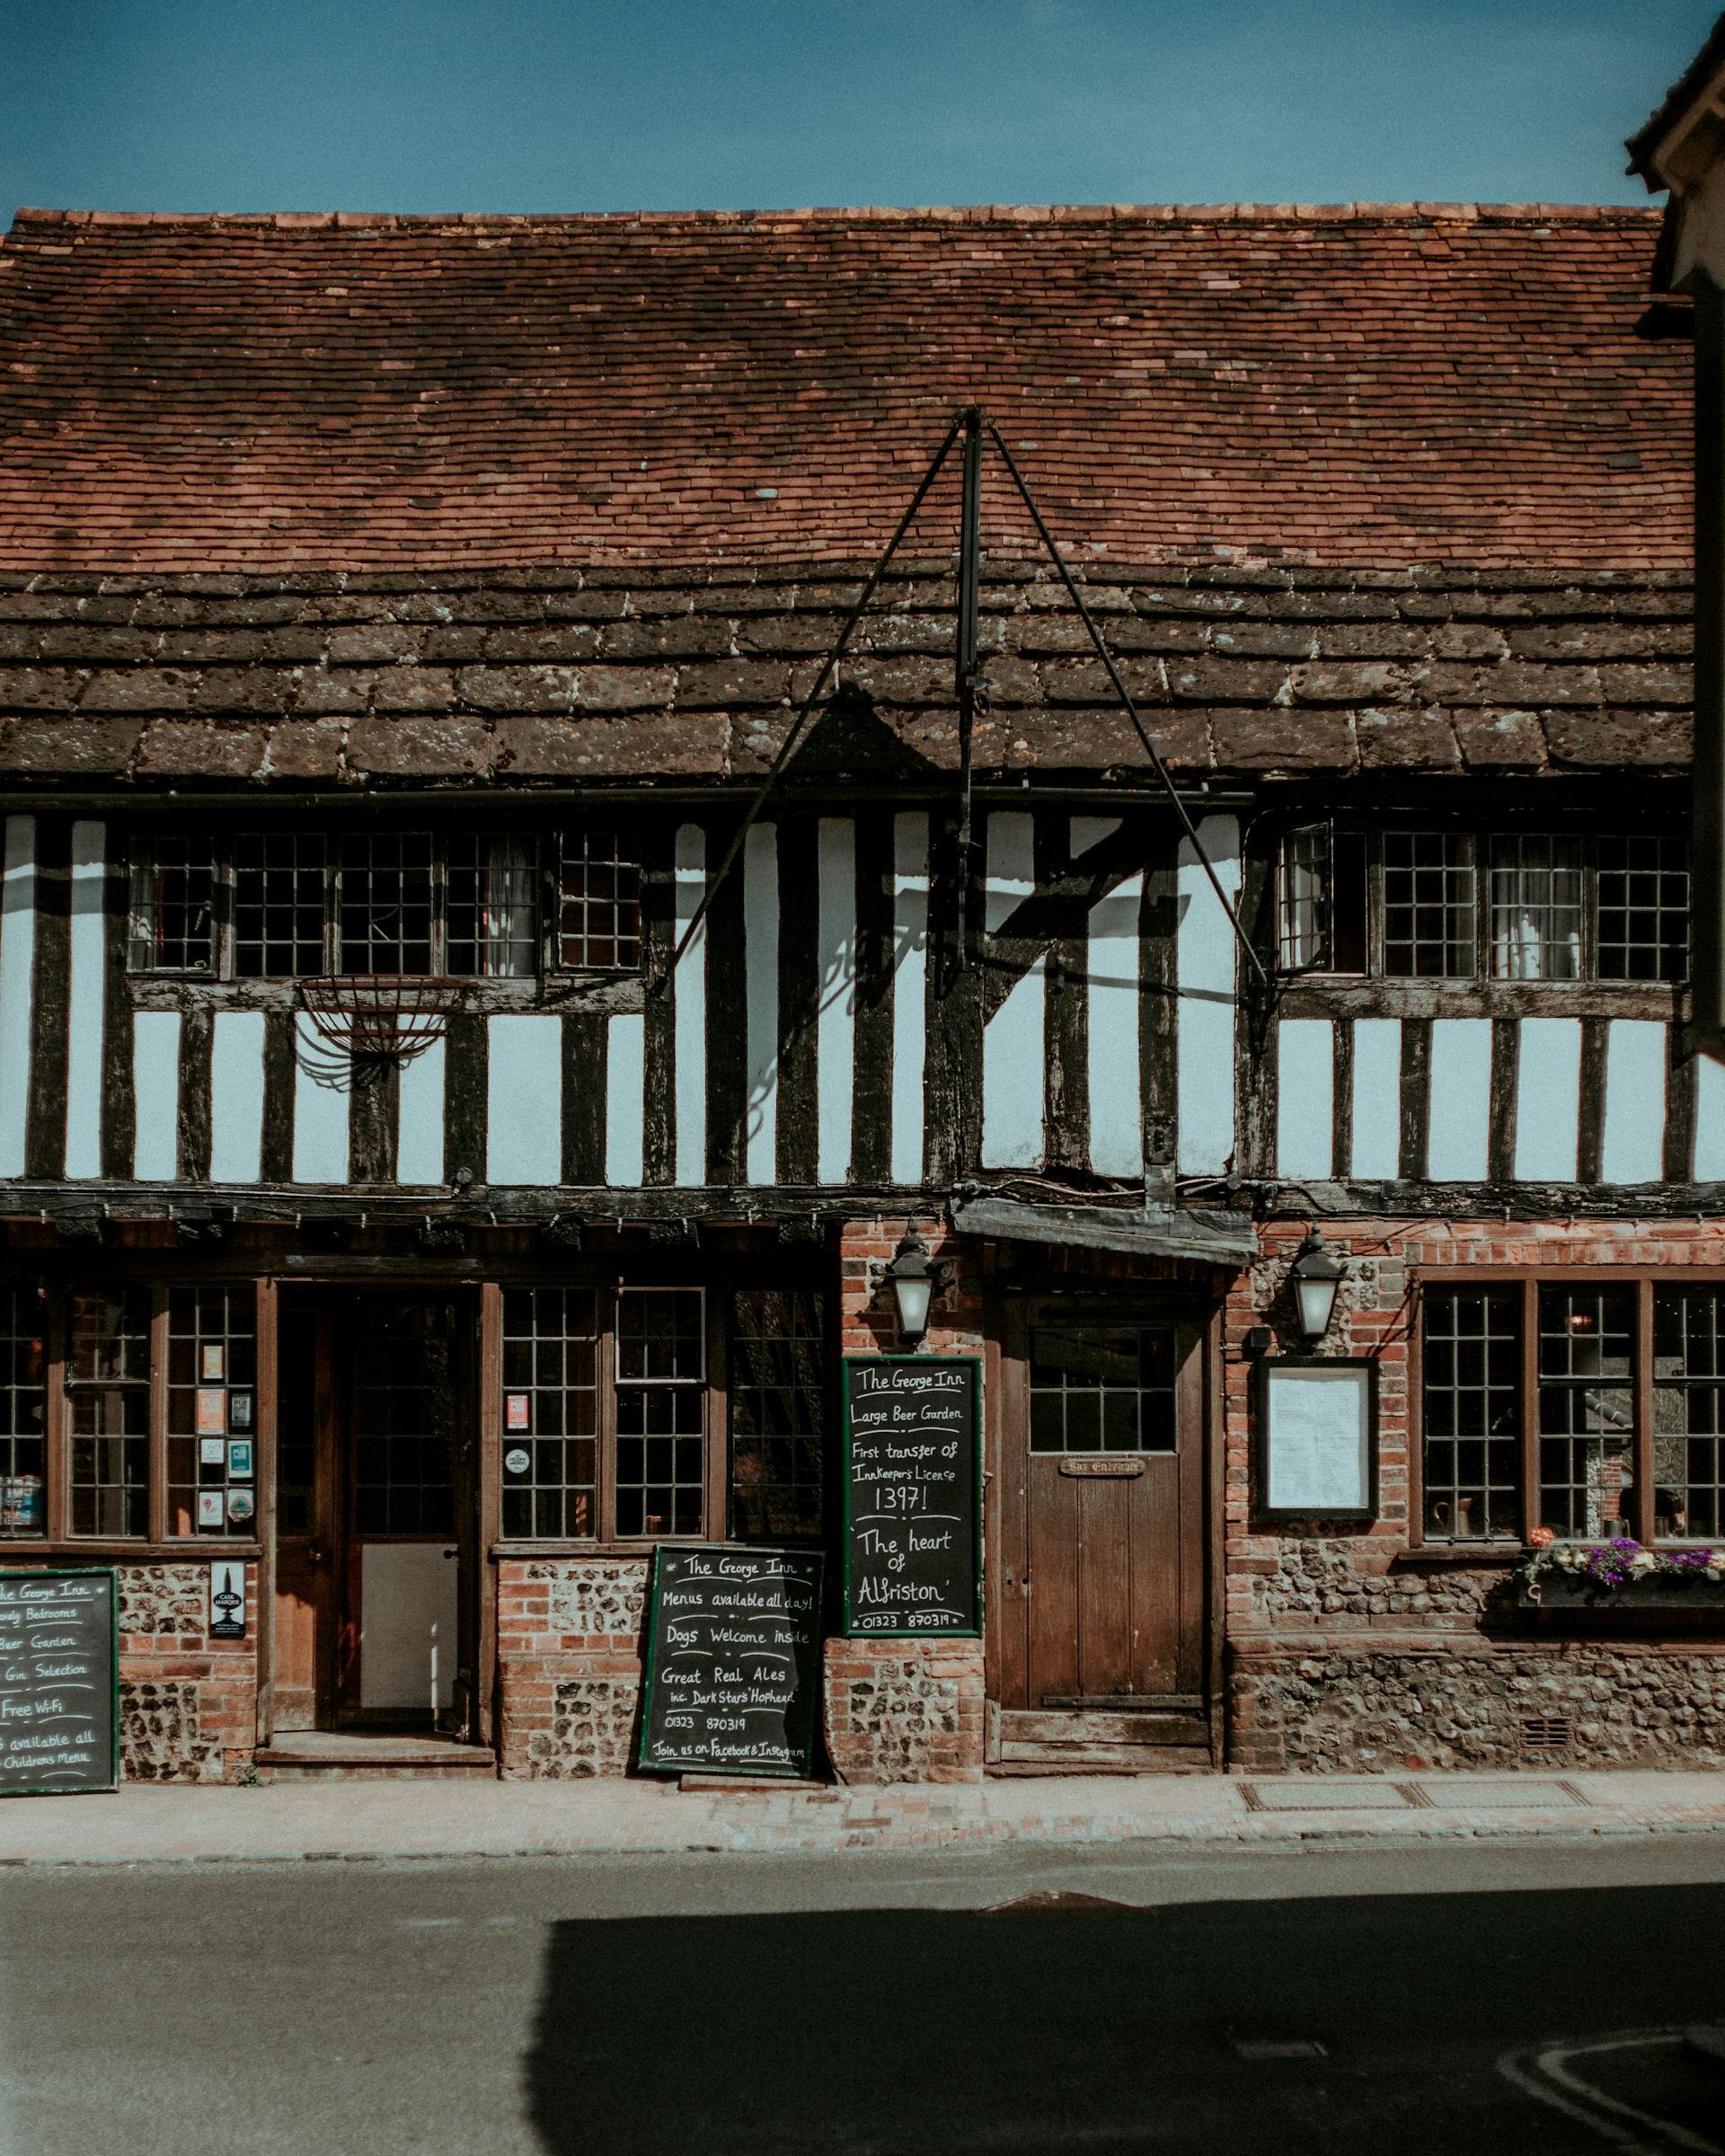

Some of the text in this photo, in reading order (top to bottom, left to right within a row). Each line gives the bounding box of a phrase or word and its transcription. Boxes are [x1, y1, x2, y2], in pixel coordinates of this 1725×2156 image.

[856, 1367, 965, 1390] The George Inn
[851, 1404, 964, 1425] Large Beer Garden
[853, 1442, 880, 1458] First
[885, 1443, 936, 1460] transfer
[876, 1485, 926, 1510] 1397!
[909, 1529, 952, 1551] heart
[684, 1554, 797, 1577] The George Inn
[0, 1581, 90, 1601] he George Inn
[662, 1592, 812, 1611] Menus available all day!
[26, 1607, 77, 1621] Bedrooms
[862, 1614, 950, 1629] 01323 870319
[0, 1635, 76, 1650] Beer Garden
[667, 1626, 809, 1648] Dogs Welcome inside
[5, 1663, 86, 1681] Gin Selection
[661, 1666, 785, 1684] Great Real Ales
[670, 1692, 688, 1702] inc.
[693, 1690, 717, 1705] Dark
[2, 1699, 63, 1719] Free Wi-Fi
[665, 1717, 746, 1730] 01323 870319
[10, 1735, 69, 1751] available
[75, 1730, 95, 1744] all
[652, 1740, 678, 1756] Join
[681, 1744, 692, 1755] us
[695, 1744, 709, 1754] on
[711, 1737, 751, 1757] Facebook
[758, 1741, 805, 1762] Instagram
[4, 1753, 91, 1769] Childrens Menu
